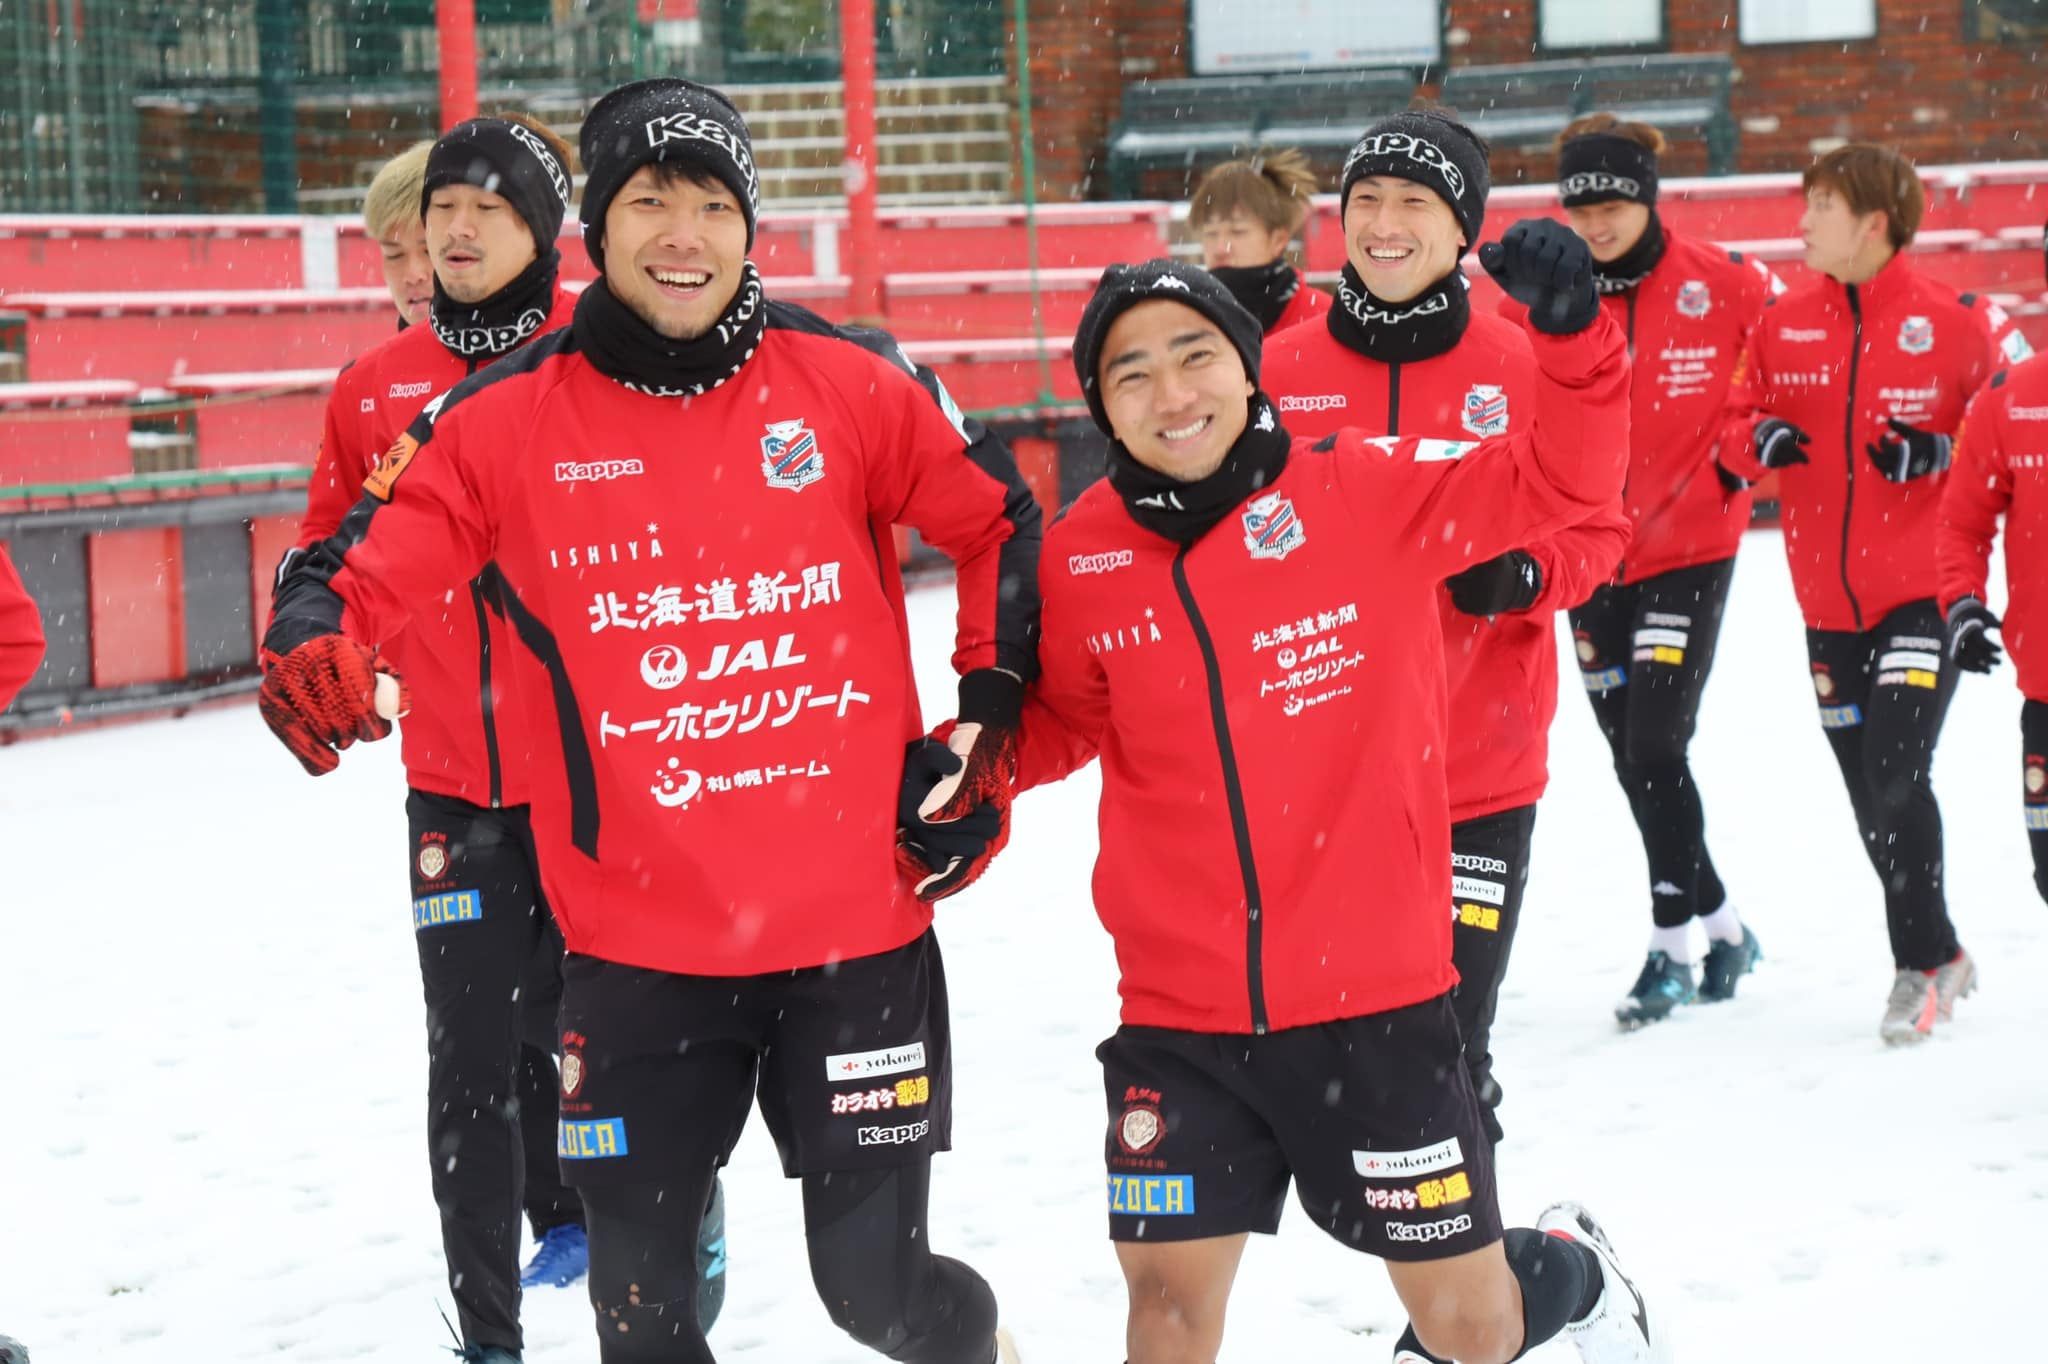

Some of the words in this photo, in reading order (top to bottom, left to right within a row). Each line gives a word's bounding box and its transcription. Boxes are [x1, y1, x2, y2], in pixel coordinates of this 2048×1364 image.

[1343, 133, 1465, 200] appa
[389, 381, 432, 398] Kappa
[1280, 394, 1347, 412] Kappa
[555, 459, 644, 482] Kappa
[550, 538, 663, 568] ISHIYA
[1069, 549, 1133, 576] Kappa
[588, 562, 842, 634] 北海道新聞
[1252, 603, 1358, 653] 北海道新聞
[697, 633, 807, 681] JAL
[1300, 636, 1344, 662] JAL
[1260, 651, 1366, 698] トーホウリゾート
[600, 680, 871, 748] トーホウリゾート
[706, 759, 832, 793] 札幌ドーム
[1451, 852, 1507, 874] appa
[866, 1047, 922, 1072] yokorei
[859, 1119, 929, 1146] Kappa
[1385, 1145, 1452, 1173] yokorei
[1386, 1214, 1472, 1242] Kappa
